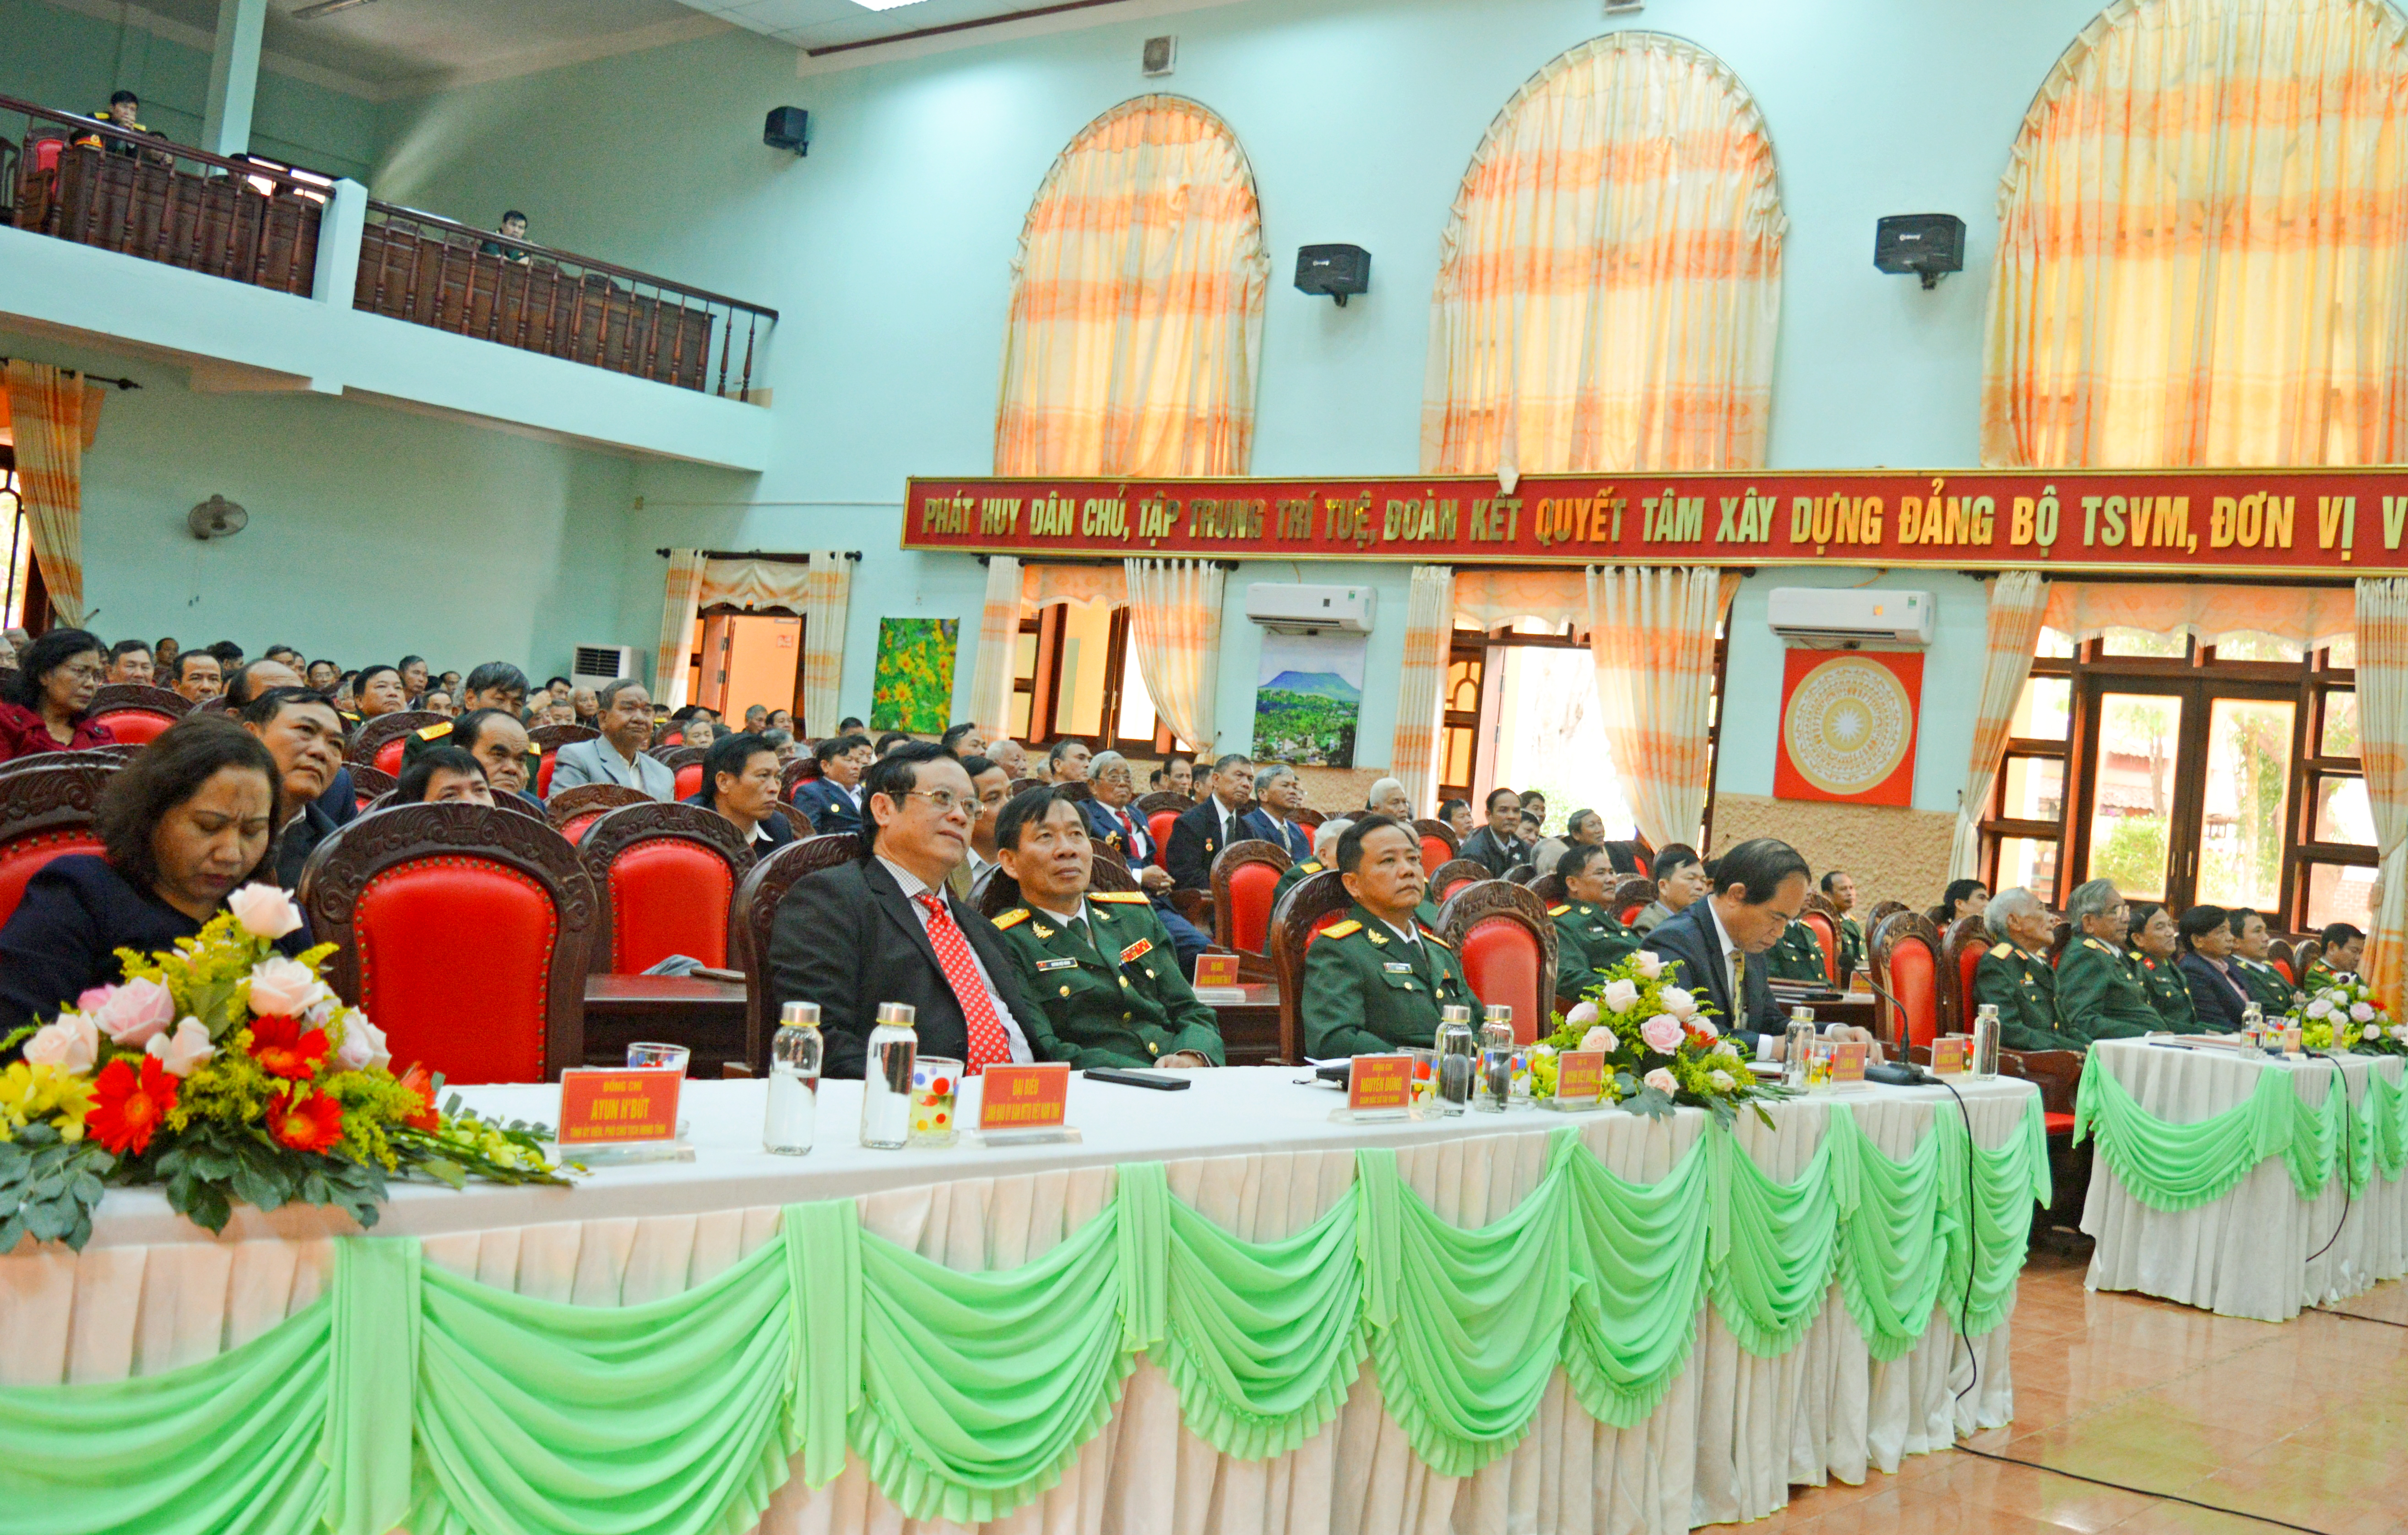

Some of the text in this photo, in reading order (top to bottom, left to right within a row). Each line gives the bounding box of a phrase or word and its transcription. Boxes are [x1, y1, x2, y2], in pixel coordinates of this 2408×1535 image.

[922, 490, 975, 535] PHÁT
[979, 498, 1021, 536] HUY
[1030, 491, 1075, 536] DÂN
[1082, 484, 1130, 542] CHỦ,
[1138, 490, 1181, 546] TẬP
[1189, 499, 1266, 539] TRUNG
[1275, 490, 1317, 539] TRÍ
[1324, 490, 1378, 549] TUỆ,
[1383, 489, 1459, 541] ĐOÀN
[1534, 486, 1627, 547] QUYẾT
[1641, 488, 1705, 543] TÂM
[1715, 487, 1778, 543] XÂY
[1790, 492, 1884, 555] DỰNG
[1898, 477, 1996, 546] ĐẢNG
[2010, 485, 2060, 557] BỘ
[2081, 495, 2198, 554] TSVM,
[2210, 491, 2295, 549] ĐƠN
[2318, 496, 2356, 561] VỊ
[591, 1099, 619, 1121] AYUN
